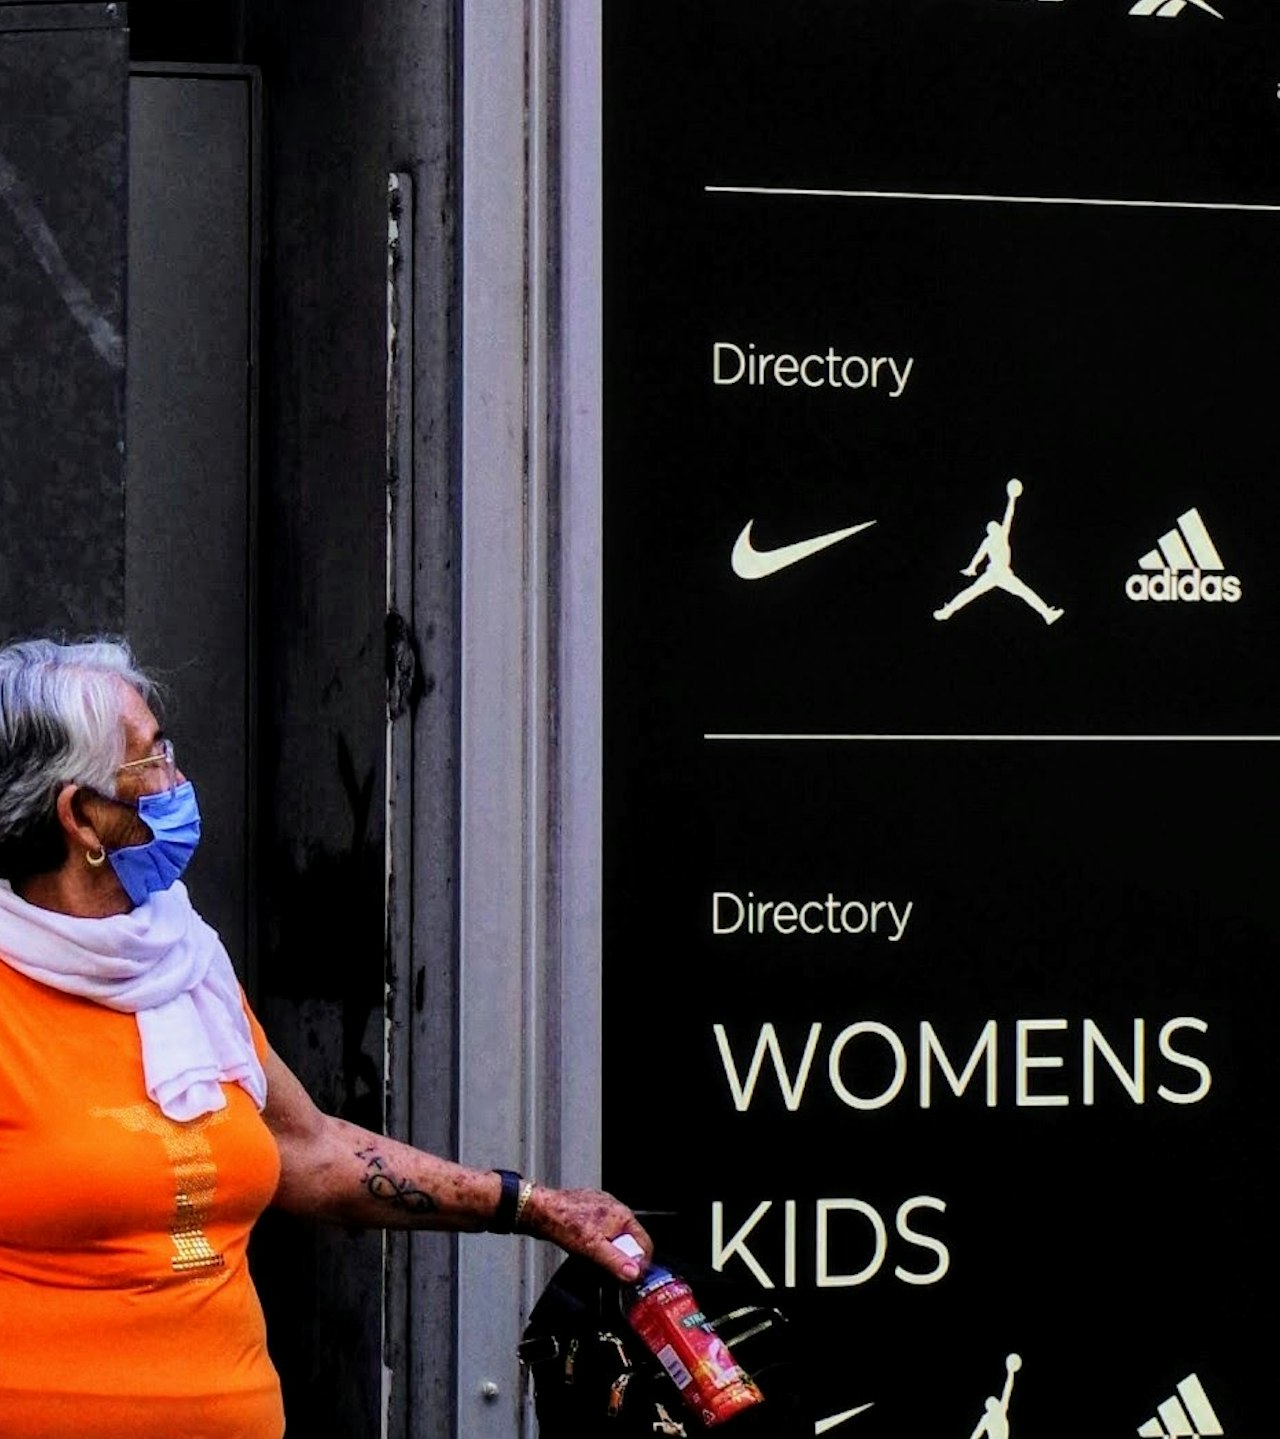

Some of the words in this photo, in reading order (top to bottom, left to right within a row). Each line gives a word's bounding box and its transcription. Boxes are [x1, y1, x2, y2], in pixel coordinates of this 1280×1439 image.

[712, 342, 914, 397] Directory
[1125, 567, 1242, 602] adidas
[711, 892, 914, 942] Directory
[713, 1016, 1213, 1112] WOMENS
[711, 1195, 951, 1289] KIDS
